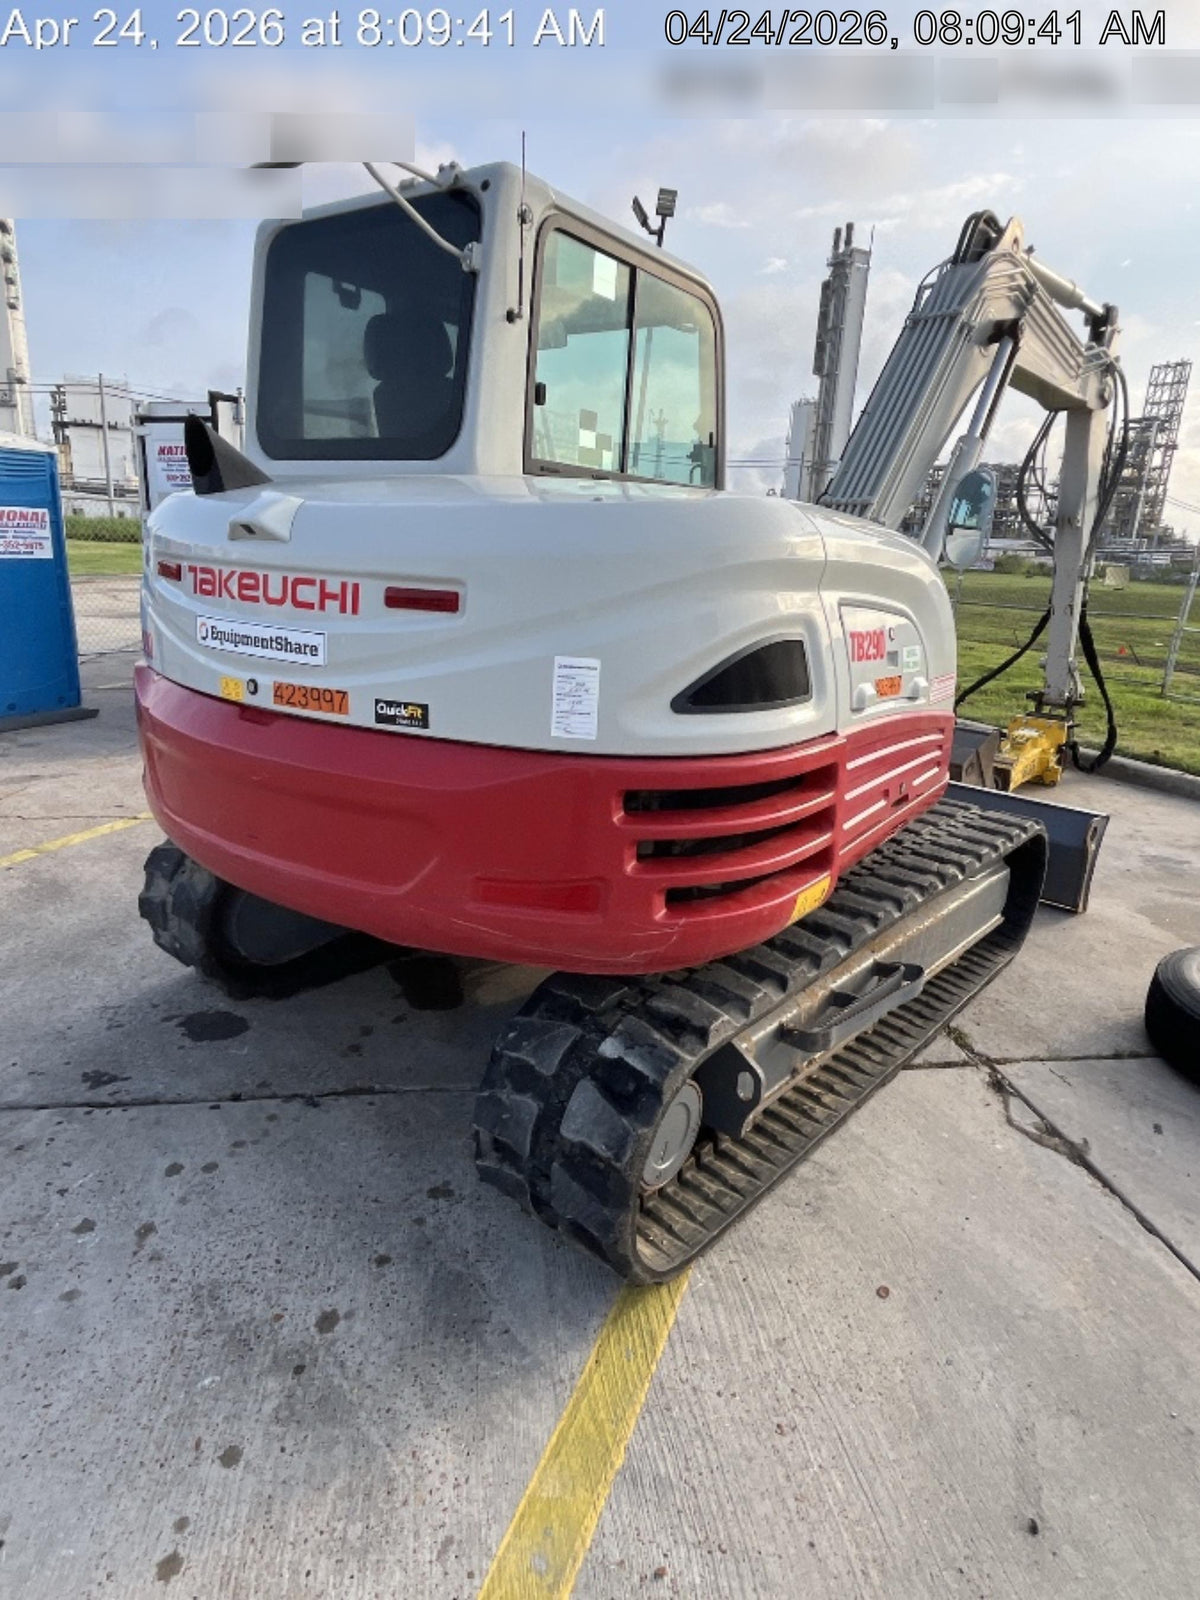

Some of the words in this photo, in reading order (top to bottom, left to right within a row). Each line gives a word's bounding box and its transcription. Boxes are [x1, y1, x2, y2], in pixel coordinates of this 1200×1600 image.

[157, 445, 189, 456] NATI
[210, 625, 319, 657] EquipmentShare
[849, 629, 886, 662] TB290
[273, 682, 348, 713] 423997
